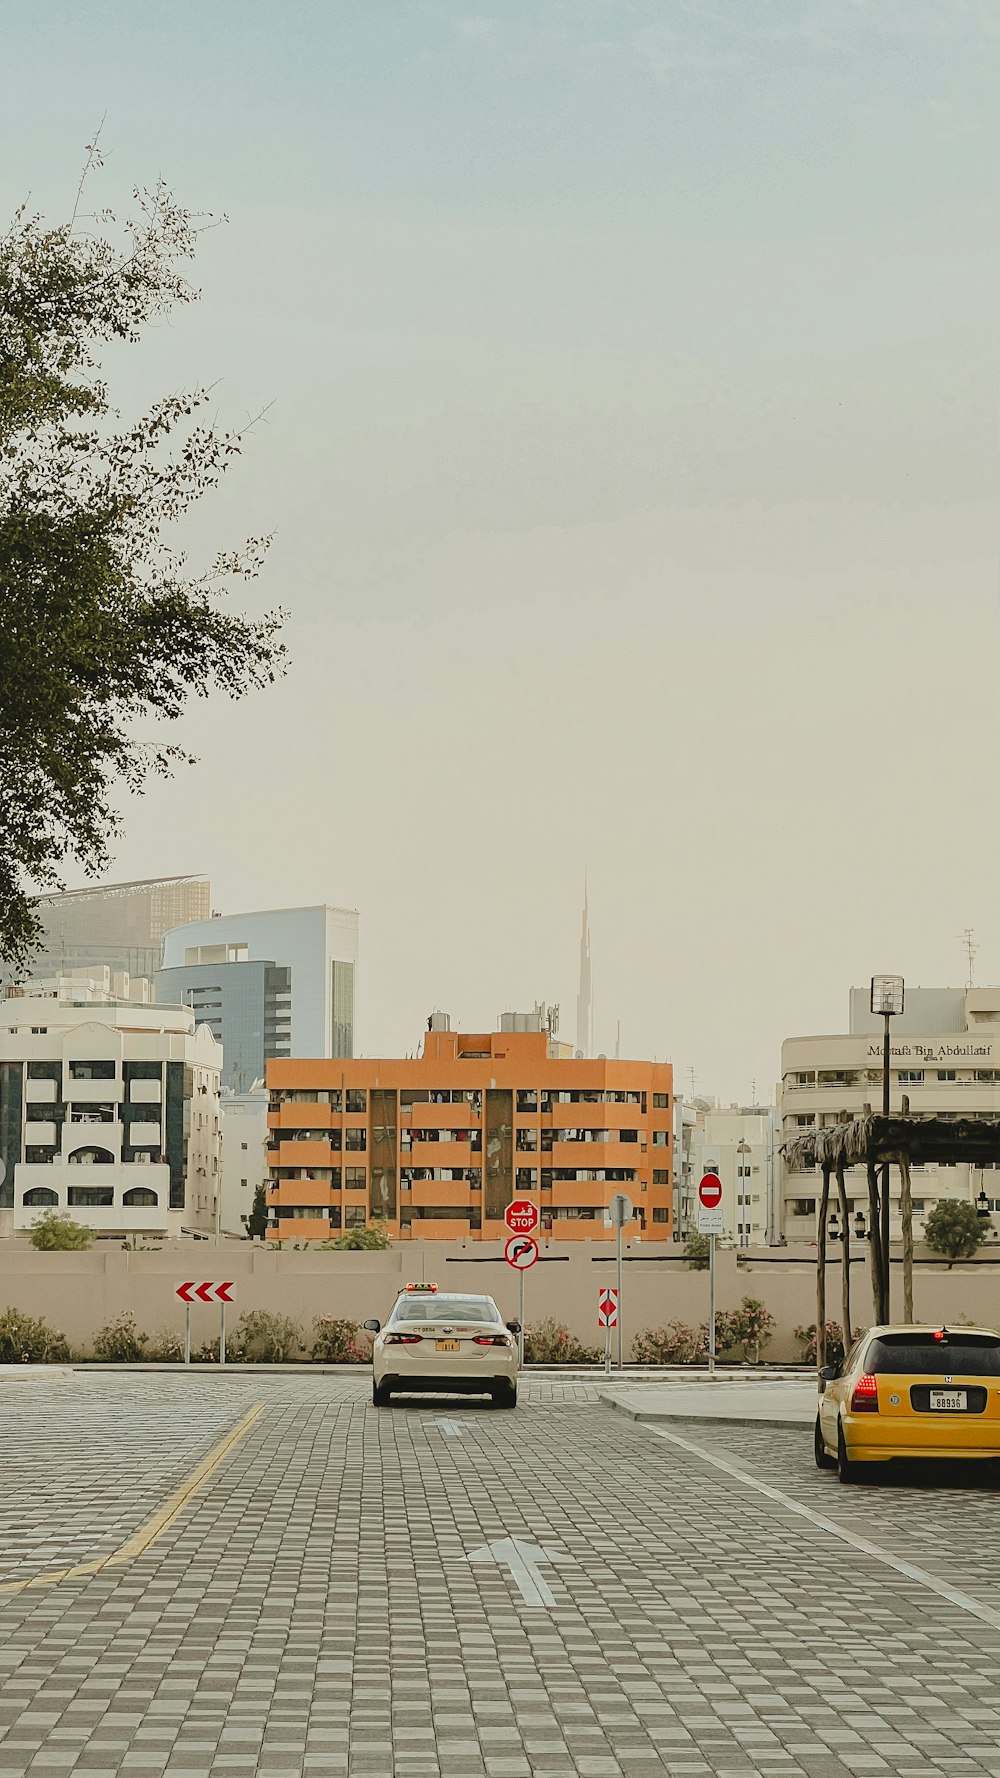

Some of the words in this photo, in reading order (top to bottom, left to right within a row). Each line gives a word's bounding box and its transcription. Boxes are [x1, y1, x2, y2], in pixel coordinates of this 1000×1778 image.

[914, 1045, 934, 1056] Bin
[937, 1044, 993, 1056] Abdullatif
[511, 1204, 533, 1216] قف
[510, 1218, 534, 1227] STOP
[936, 1398, 961, 1408] 88936
